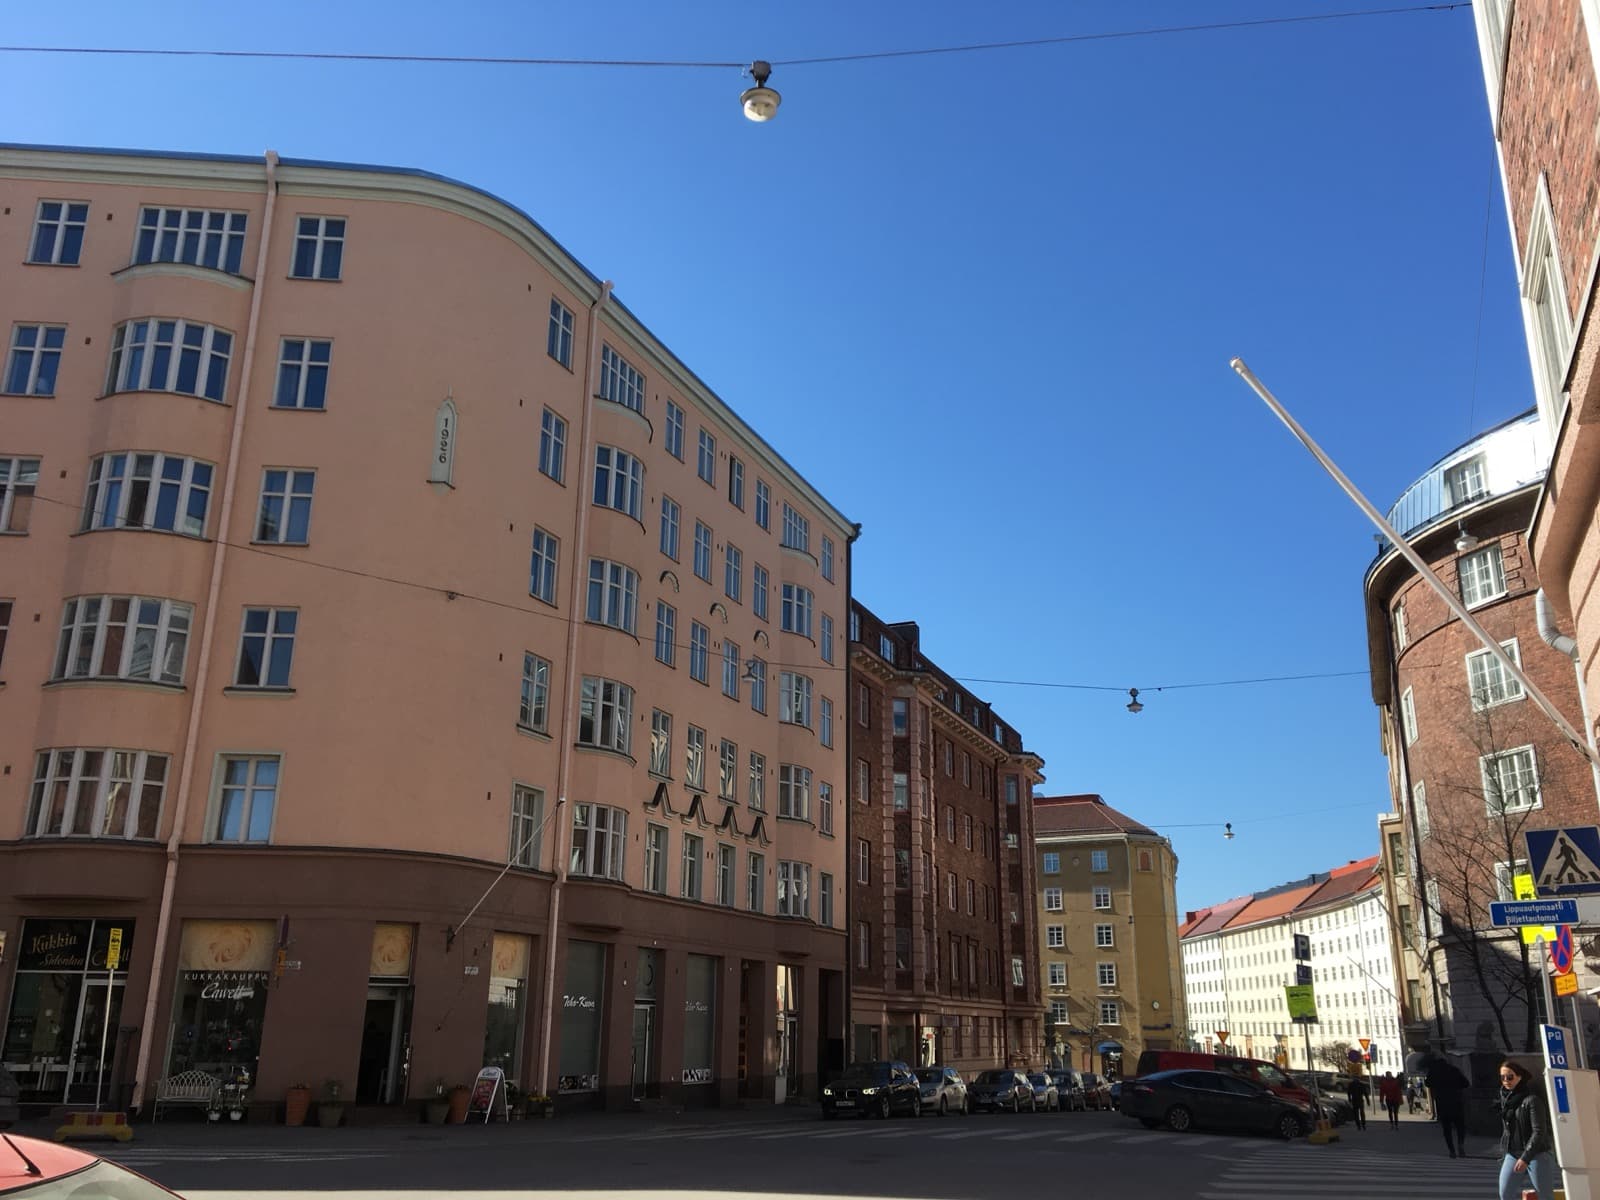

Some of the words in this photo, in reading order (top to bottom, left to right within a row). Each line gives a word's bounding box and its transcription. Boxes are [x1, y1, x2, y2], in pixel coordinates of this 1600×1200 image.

[439, 418, 449, 464] 1926
[1504, 902, 1564, 913] Lippuautomaatti
[184, 973, 268, 981] KUKKAKAUPPA
[1551, 1055, 1565, 1065] 10
[1557, 1078, 1562, 1089] 1
